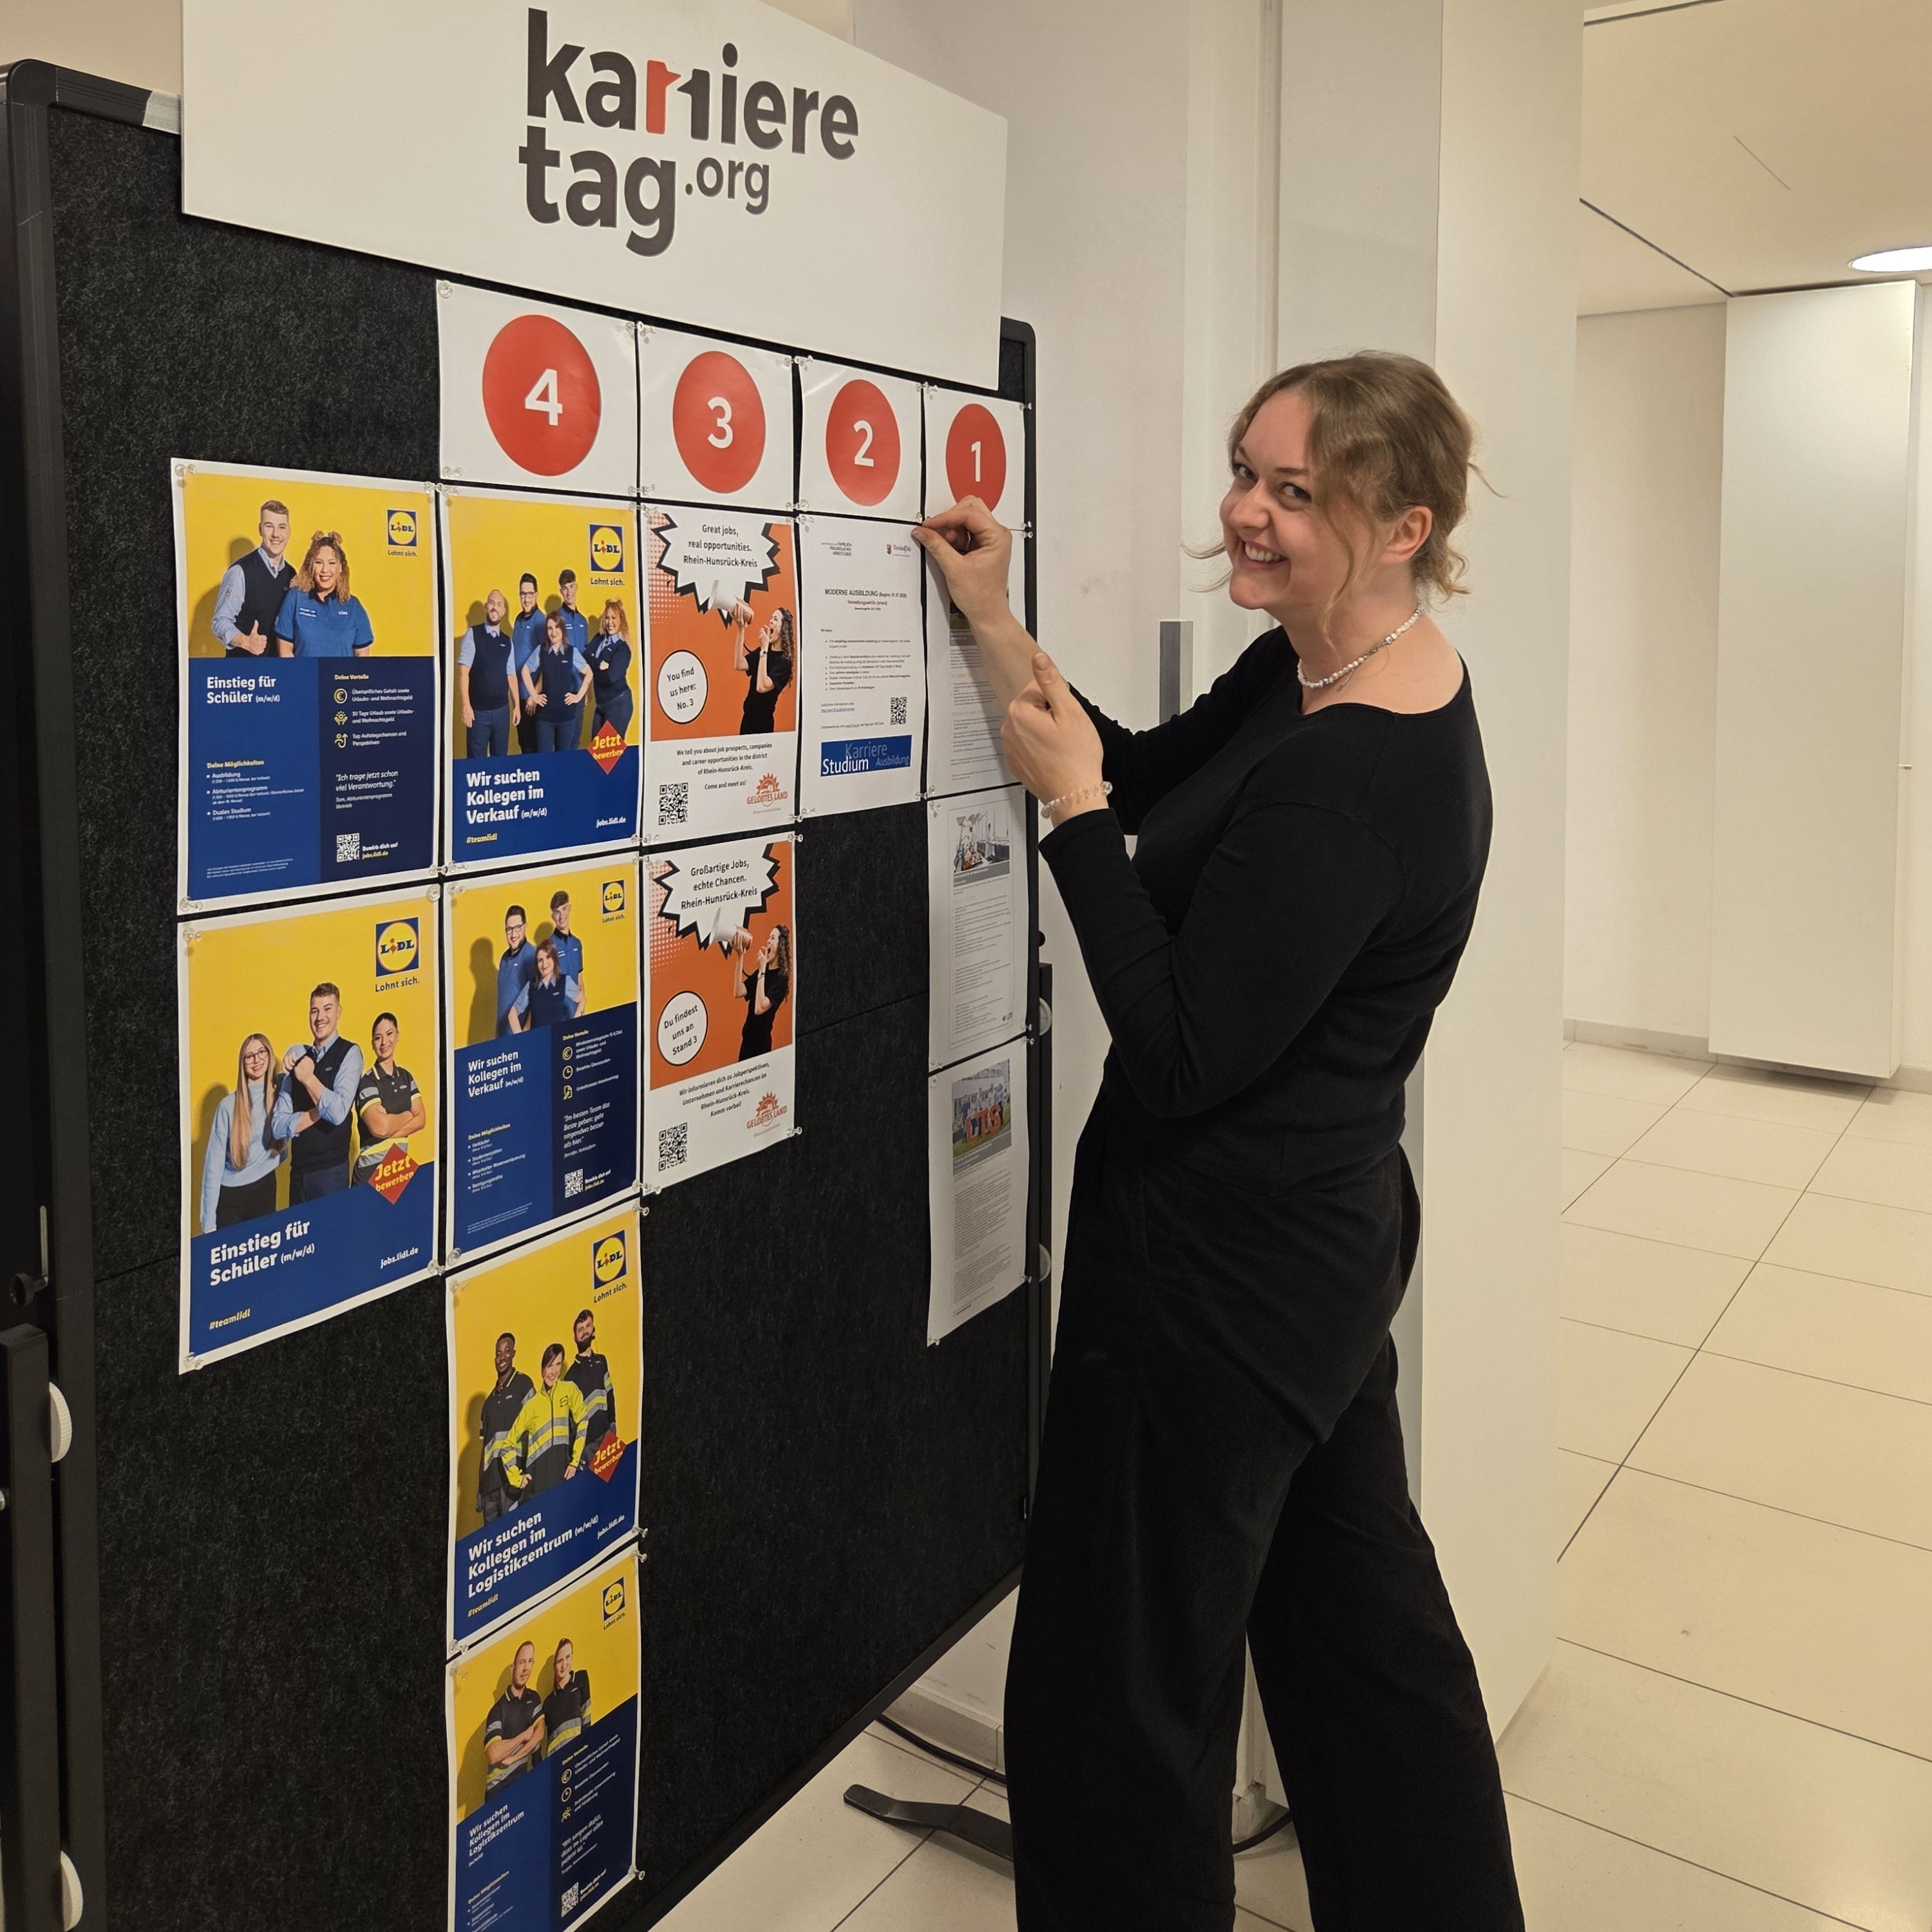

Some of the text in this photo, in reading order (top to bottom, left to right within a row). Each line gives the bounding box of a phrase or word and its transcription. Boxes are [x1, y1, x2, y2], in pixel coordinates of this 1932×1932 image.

[524, 368, 564, 426] 4
[706, 396, 734, 449] 3
[853, 420, 875, 468] 2
[970, 440, 981, 482] 1
[703, 524, 739, 536] Great jobs,
[688, 540, 752, 552] real opportunities.
[683, 555, 757, 567] Rhein-Hunsrück-Kreis
[207, 676, 276, 690] Einstieg für
[667, 667, 695, 682] You find
[207, 691, 253, 703] Schüler
[670, 683, 696, 697] us here:
[677, 698, 694, 710] No. 3
[592, 734, 621, 750] Jetzt
[694, 748, 703, 756] you
[703, 746, 717, 754] about
[726, 744, 748, 753] prospects,
[749, 742, 772, 750] companies
[845, 742, 887, 759] Karriere
[593, 748, 623, 760] bewerben
[708, 755, 738, 764] opportunities
[876, 755, 909, 766] Ausbildung
[822, 755, 869, 775] Studium
[366, 772, 380, 780] jetzt
[466, 768, 540, 787] Wir suchen
[466, 786, 544, 806] Kollegen im
[466, 805, 547, 824] Verkauf (m/w/d)
[691, 858, 749, 876] Großartige Jobs,
[694, 875, 746, 891] echte Chancen.
[681, 887, 757, 910] Rhein-Hunsrück-Kreis
[375, 976, 420, 992] Lohnt sich.
[664, 1005, 698, 1029] Du findest
[672, 1023, 694, 1041] uns an
[672, 1036, 697, 1056] Stand 3
[468, 1051, 518, 1072] Wir suchen
[468, 1063, 522, 1085] Kollegen im
[679, 1088, 688, 1096] Wir
[688, 1080, 715, 1094] informieren
[716, 1076, 726, 1085] dich
[733, 1062, 770, 1080] Jobperspektiven,
[468, 1078, 504, 1097] Verkauf
[683, 1091, 715, 1106] Unternehmen
[725, 1075, 761, 1093] Karrierechancen
[710, 1101, 742, 1117] Komm vorbei!
[966, 1104, 1001, 1144] LTS
[375, 1155, 411, 1180] Jetzt
[375, 1171, 414, 1192] bewerben
[211, 1220, 310, 1265] Einstieg für
[211, 1243, 315, 1286] Schüler (m/w/d)
[381, 1247, 419, 1269] jobs.lidl.de
[594, 1282, 627, 1303] Lohnt sich.
[209, 1309, 251, 1330] #teamlidl
[594, 1439, 621, 1465] Jetzt
[469, 1512, 542, 1561] Wir suchen
[468, 1528, 573, 1598] Logistikzentrum
[469, 1527, 545, 1580] Kollegen im
[469, 1804, 508, 1837] Wir suchen
[469, 1812, 510, 1848] Kollegen im
[469, 1811, 524, 1857] Logistikzentrum
